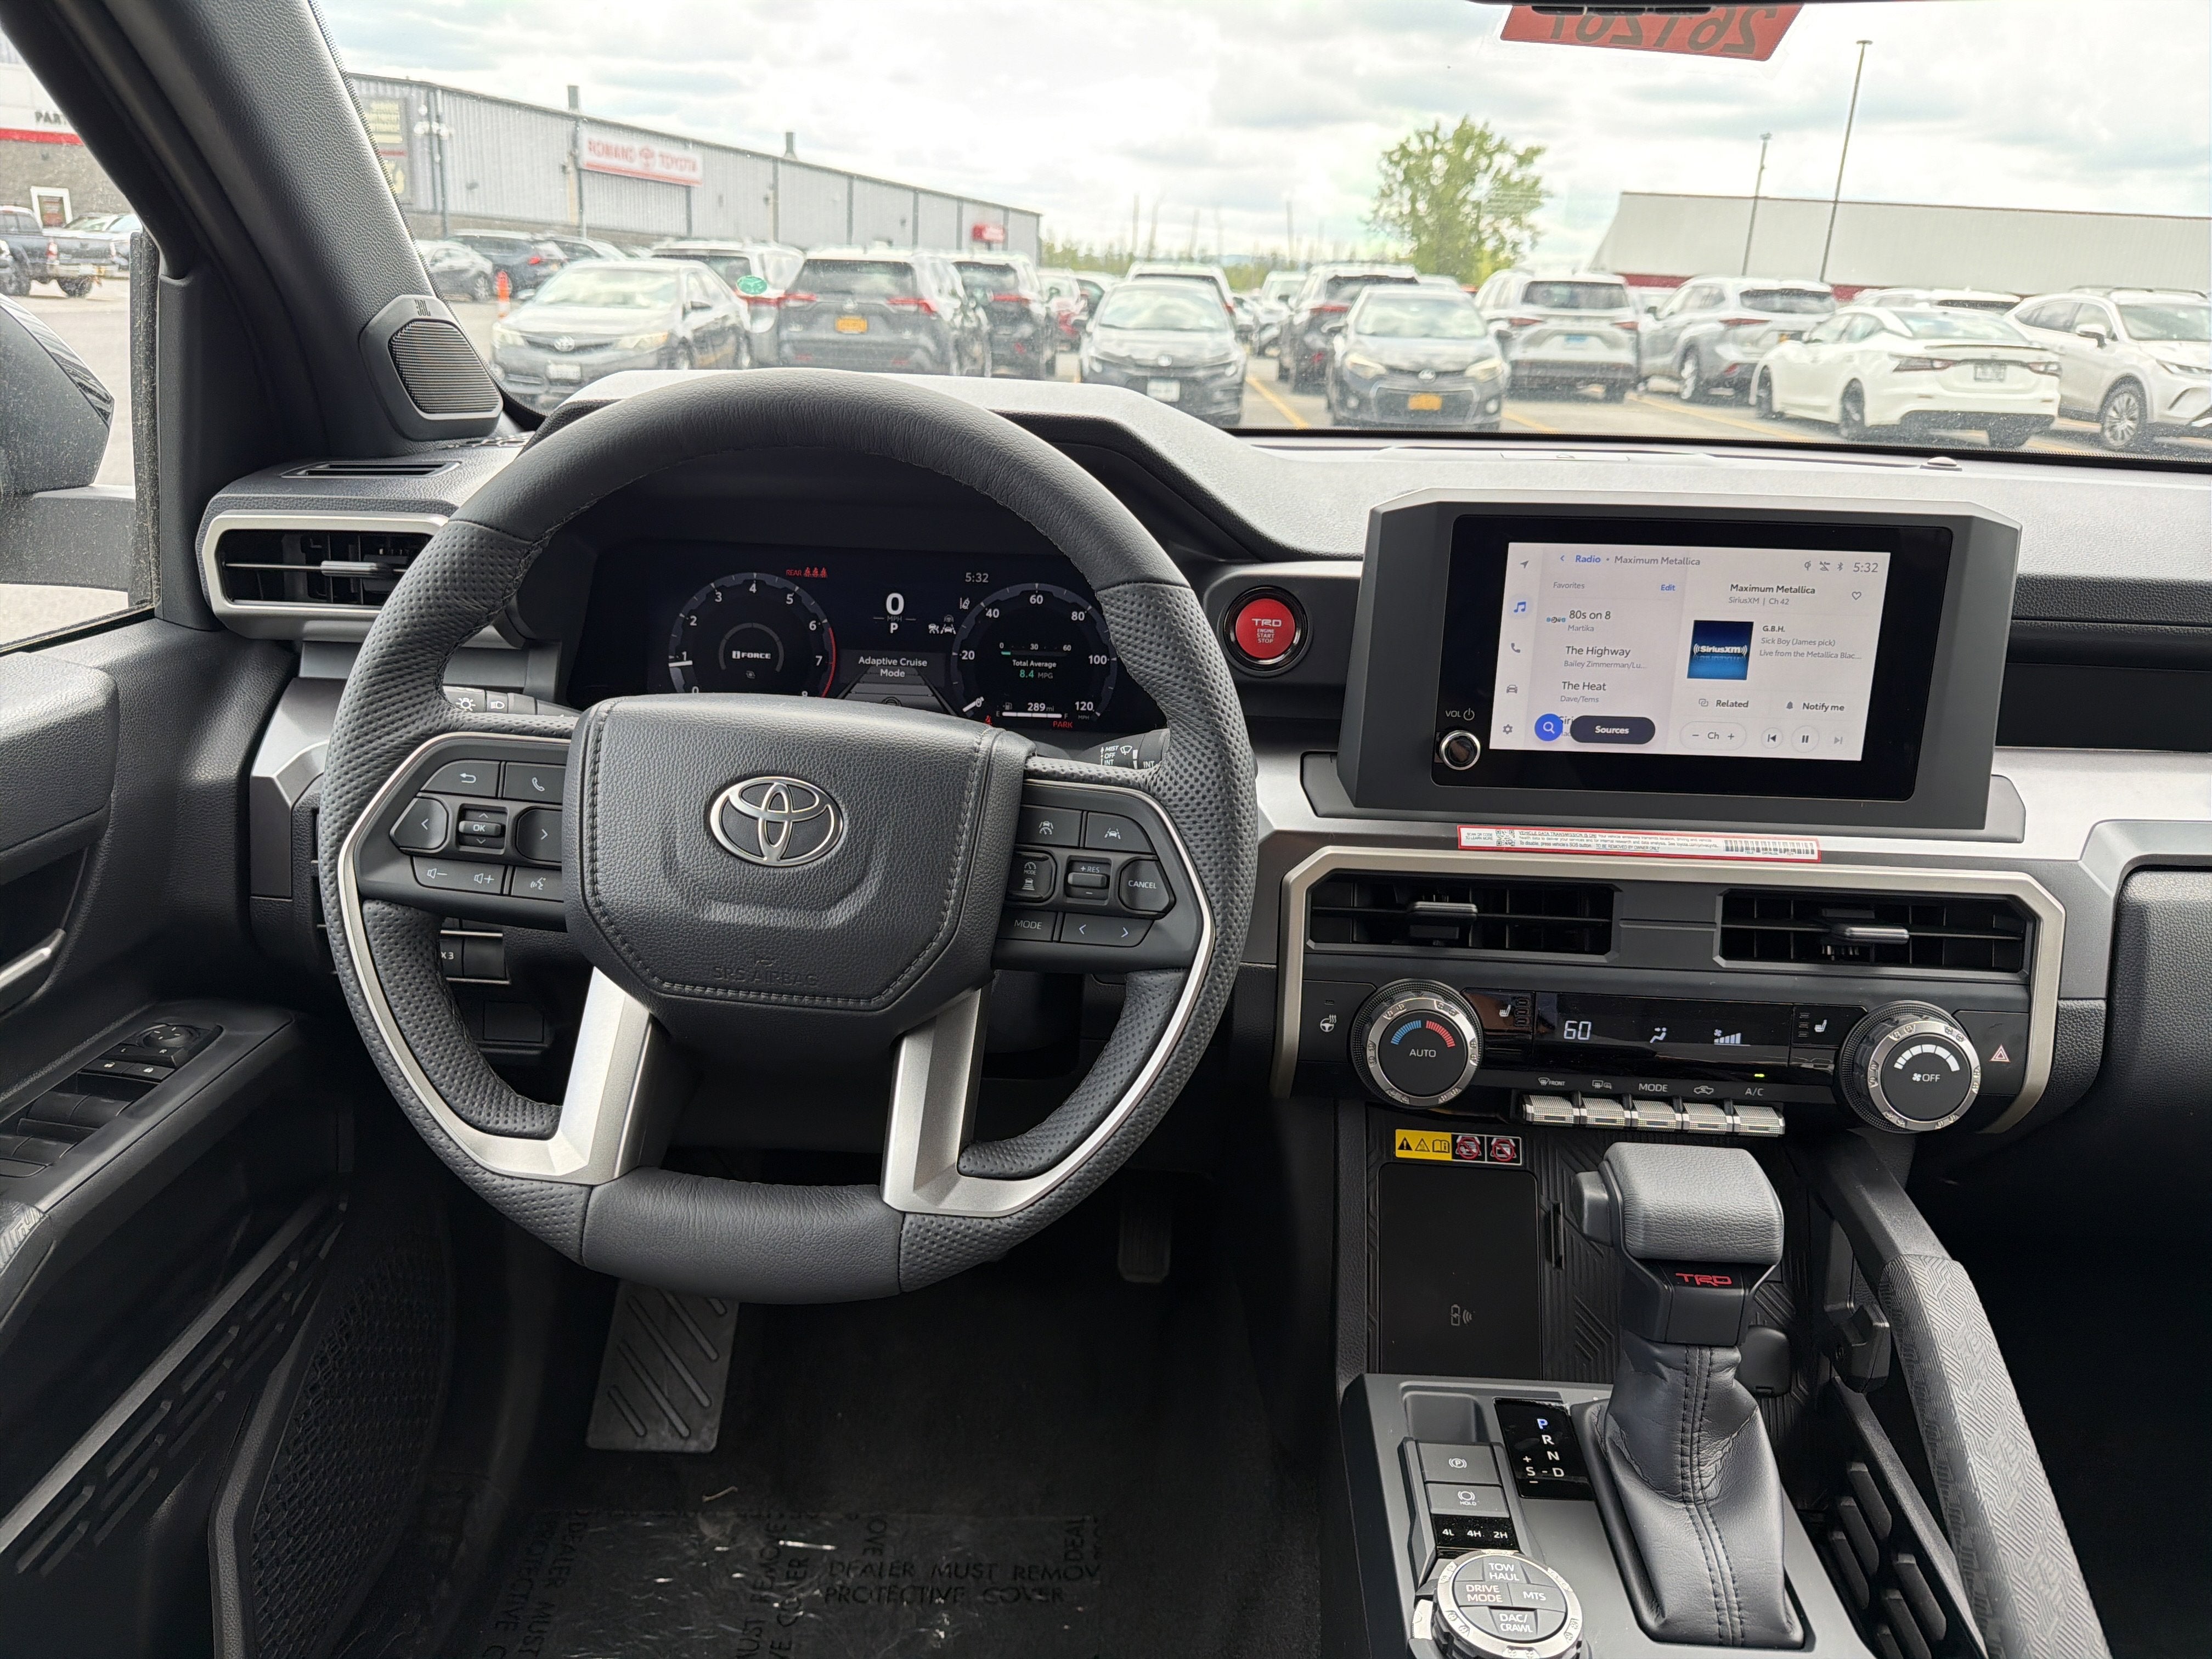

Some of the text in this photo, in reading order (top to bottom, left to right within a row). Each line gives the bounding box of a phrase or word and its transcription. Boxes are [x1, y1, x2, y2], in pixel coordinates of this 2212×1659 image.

[414, 299, 431, 317] JBL
[1575, 555, 1700, 566] Radio Maximum Metallica
[1853, 562, 1878, 573] 5:32
[965, 573, 989, 583] 5:32
[749, 583, 757, 594] 4
[1730, 584, 1815, 594] Maximum Metallica
[715, 591, 723, 602] 3
[786, 594, 793, 605] 5
[1029, 595, 1043, 604] 60
[1729, 596, 1759, 605] SiriusXM
[886, 593, 905, 616] 0
[985, 608, 1000, 618] 40
[1071, 611, 1085, 620] 80
[1569, 610, 1587, 619] 80s
[1605, 611, 1611, 620] 8
[690, 616, 697, 626] 2
[809, 620, 817, 630] 6
[1251, 618, 1282, 627] TRD
[890, 623, 899, 634] P
[1778, 638, 1790, 646] Boy
[1792, 638, 1816, 646] (James
[1818, 639, 1836, 647] pick)
[682, 651, 687, 661] 1
[962, 651, 975, 660] 20
[1566, 646, 1631, 658] The Highway
[815, 656, 822, 666] 7
[859, 656, 928, 667] Adaptive Cruise
[1088, 655, 1107, 664] 100
[880, 669, 905, 678] Mode
[1019, 669, 1034, 678] 8.4
[1562, 681, 1606, 691] The Heat
[1560, 695, 1599, 703] Dave/Tems
[1716, 699, 1749, 708] Related
[1027, 703, 1046, 711] 289
[1075, 701, 1093, 711] 120
[1803, 702, 1829, 712] Notify
[1595, 726, 1629, 735] Sources
[1707, 732, 1719, 740] Ch
[1143, 760, 1155, 769] INT
[1128, 880, 1157, 889] CANCEL
[1014, 919, 1042, 930] MODE
[1564, 1021, 1592, 1040] 60
[1409, 1048, 1436, 1058] AUTO
[1922, 1074, 1940, 1082] OFF
[1639, 1083, 1668, 1093] MODE
[1745, 1087, 1764, 1097] A/C
[1675, 1273, 1732, 1286] TRD
[1537, 1418, 1548, 1429] P
[1542, 1434, 1555, 1446] R
[1548, 1451, 1559, 1461] N
[1526, 1466, 1565, 1478] S D
[1442, 1528, 1455, 1537] 4L
[1466, 1530, 1482, 1538] 4H
[1493, 1531, 1508, 1539] 2H
[829, 1559, 915, 1579] DEALER
[932, 1561, 999, 1582] MUST
[1488, 1562, 1515, 1572] TOW
[1489, 1572, 1520, 1582] HAUL
[1466, 1584, 1500, 1593] DRIVE
[824, 1585, 1065, 1605] PROTECTIVE COVER
[1467, 1593, 1503, 1602] MODE
[1523, 1592, 1547, 1601] MTS
[1499, 1613, 1528, 1623] DAC/
[1500, 1623, 1533, 1633] CRAWL
